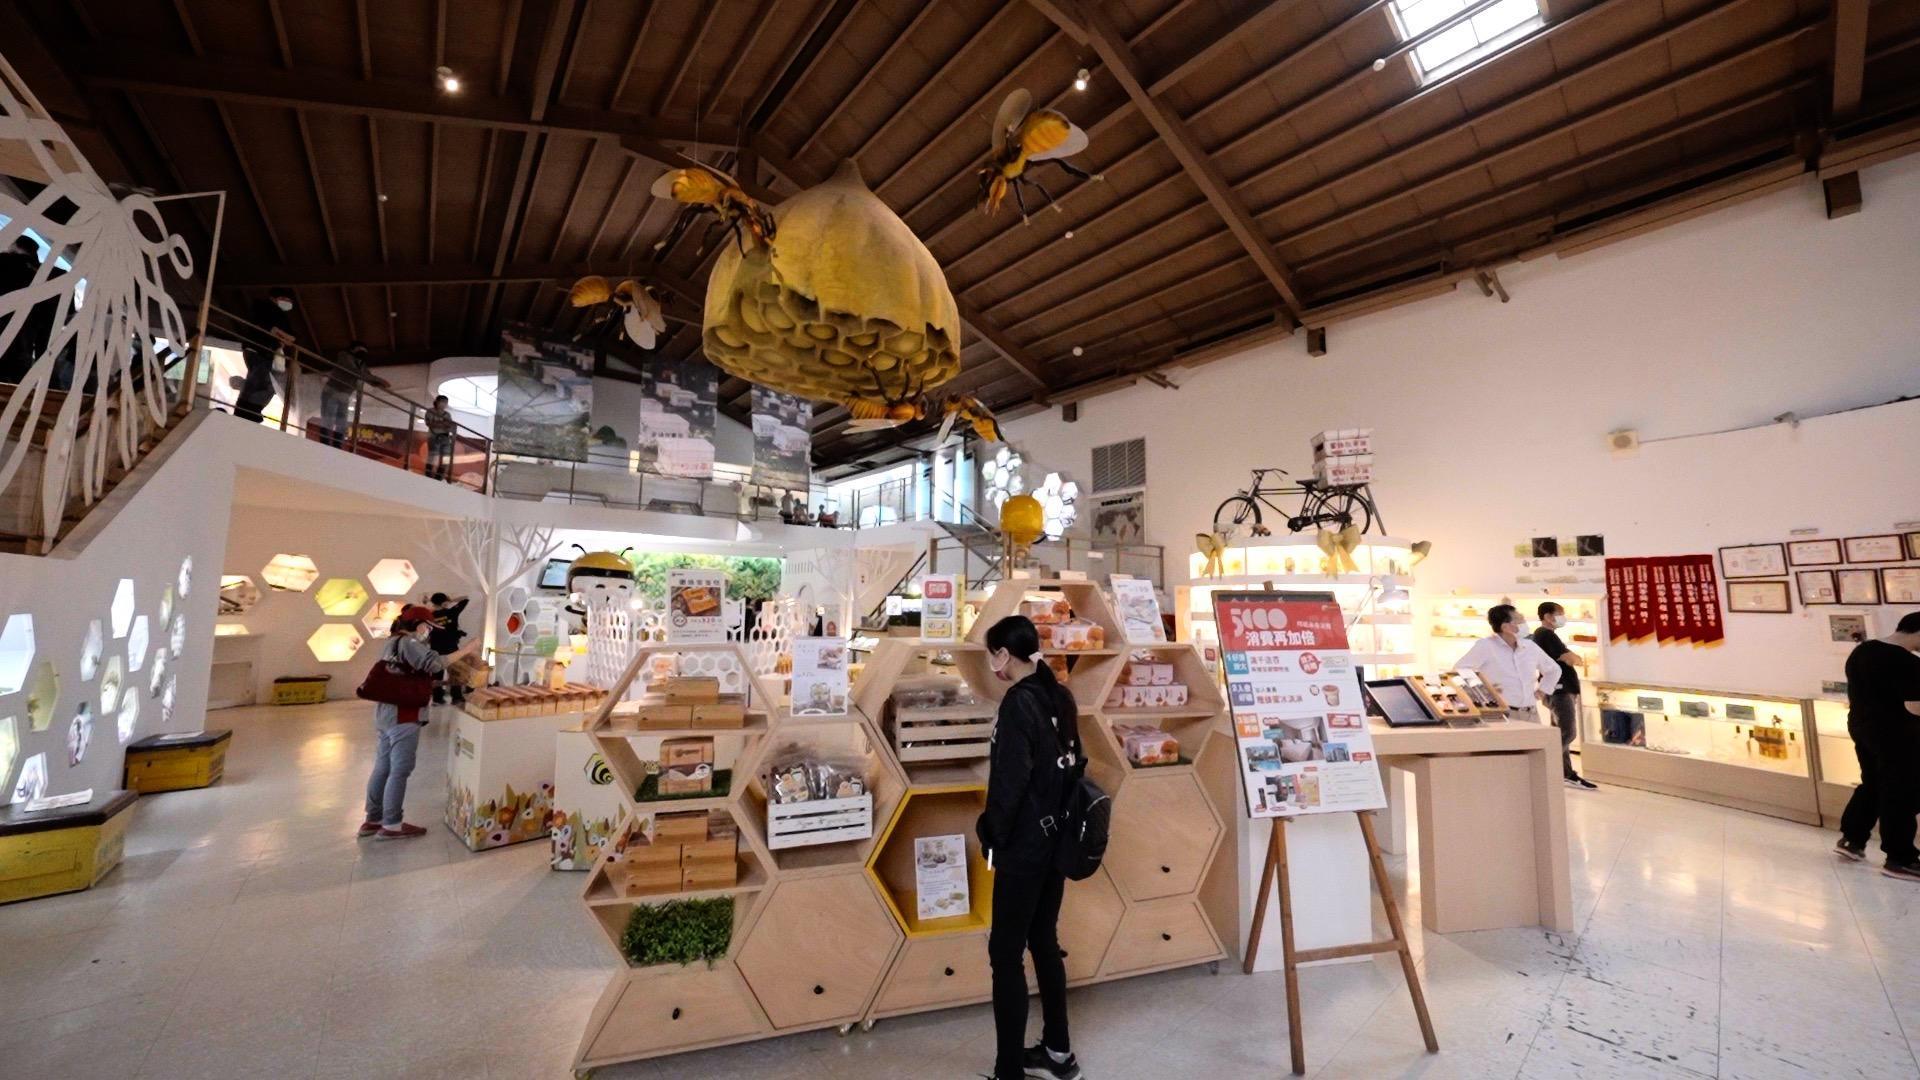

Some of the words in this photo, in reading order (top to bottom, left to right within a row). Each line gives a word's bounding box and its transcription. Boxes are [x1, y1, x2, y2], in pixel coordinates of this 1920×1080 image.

[1245, 630, 1315, 646] 消費再加倍
